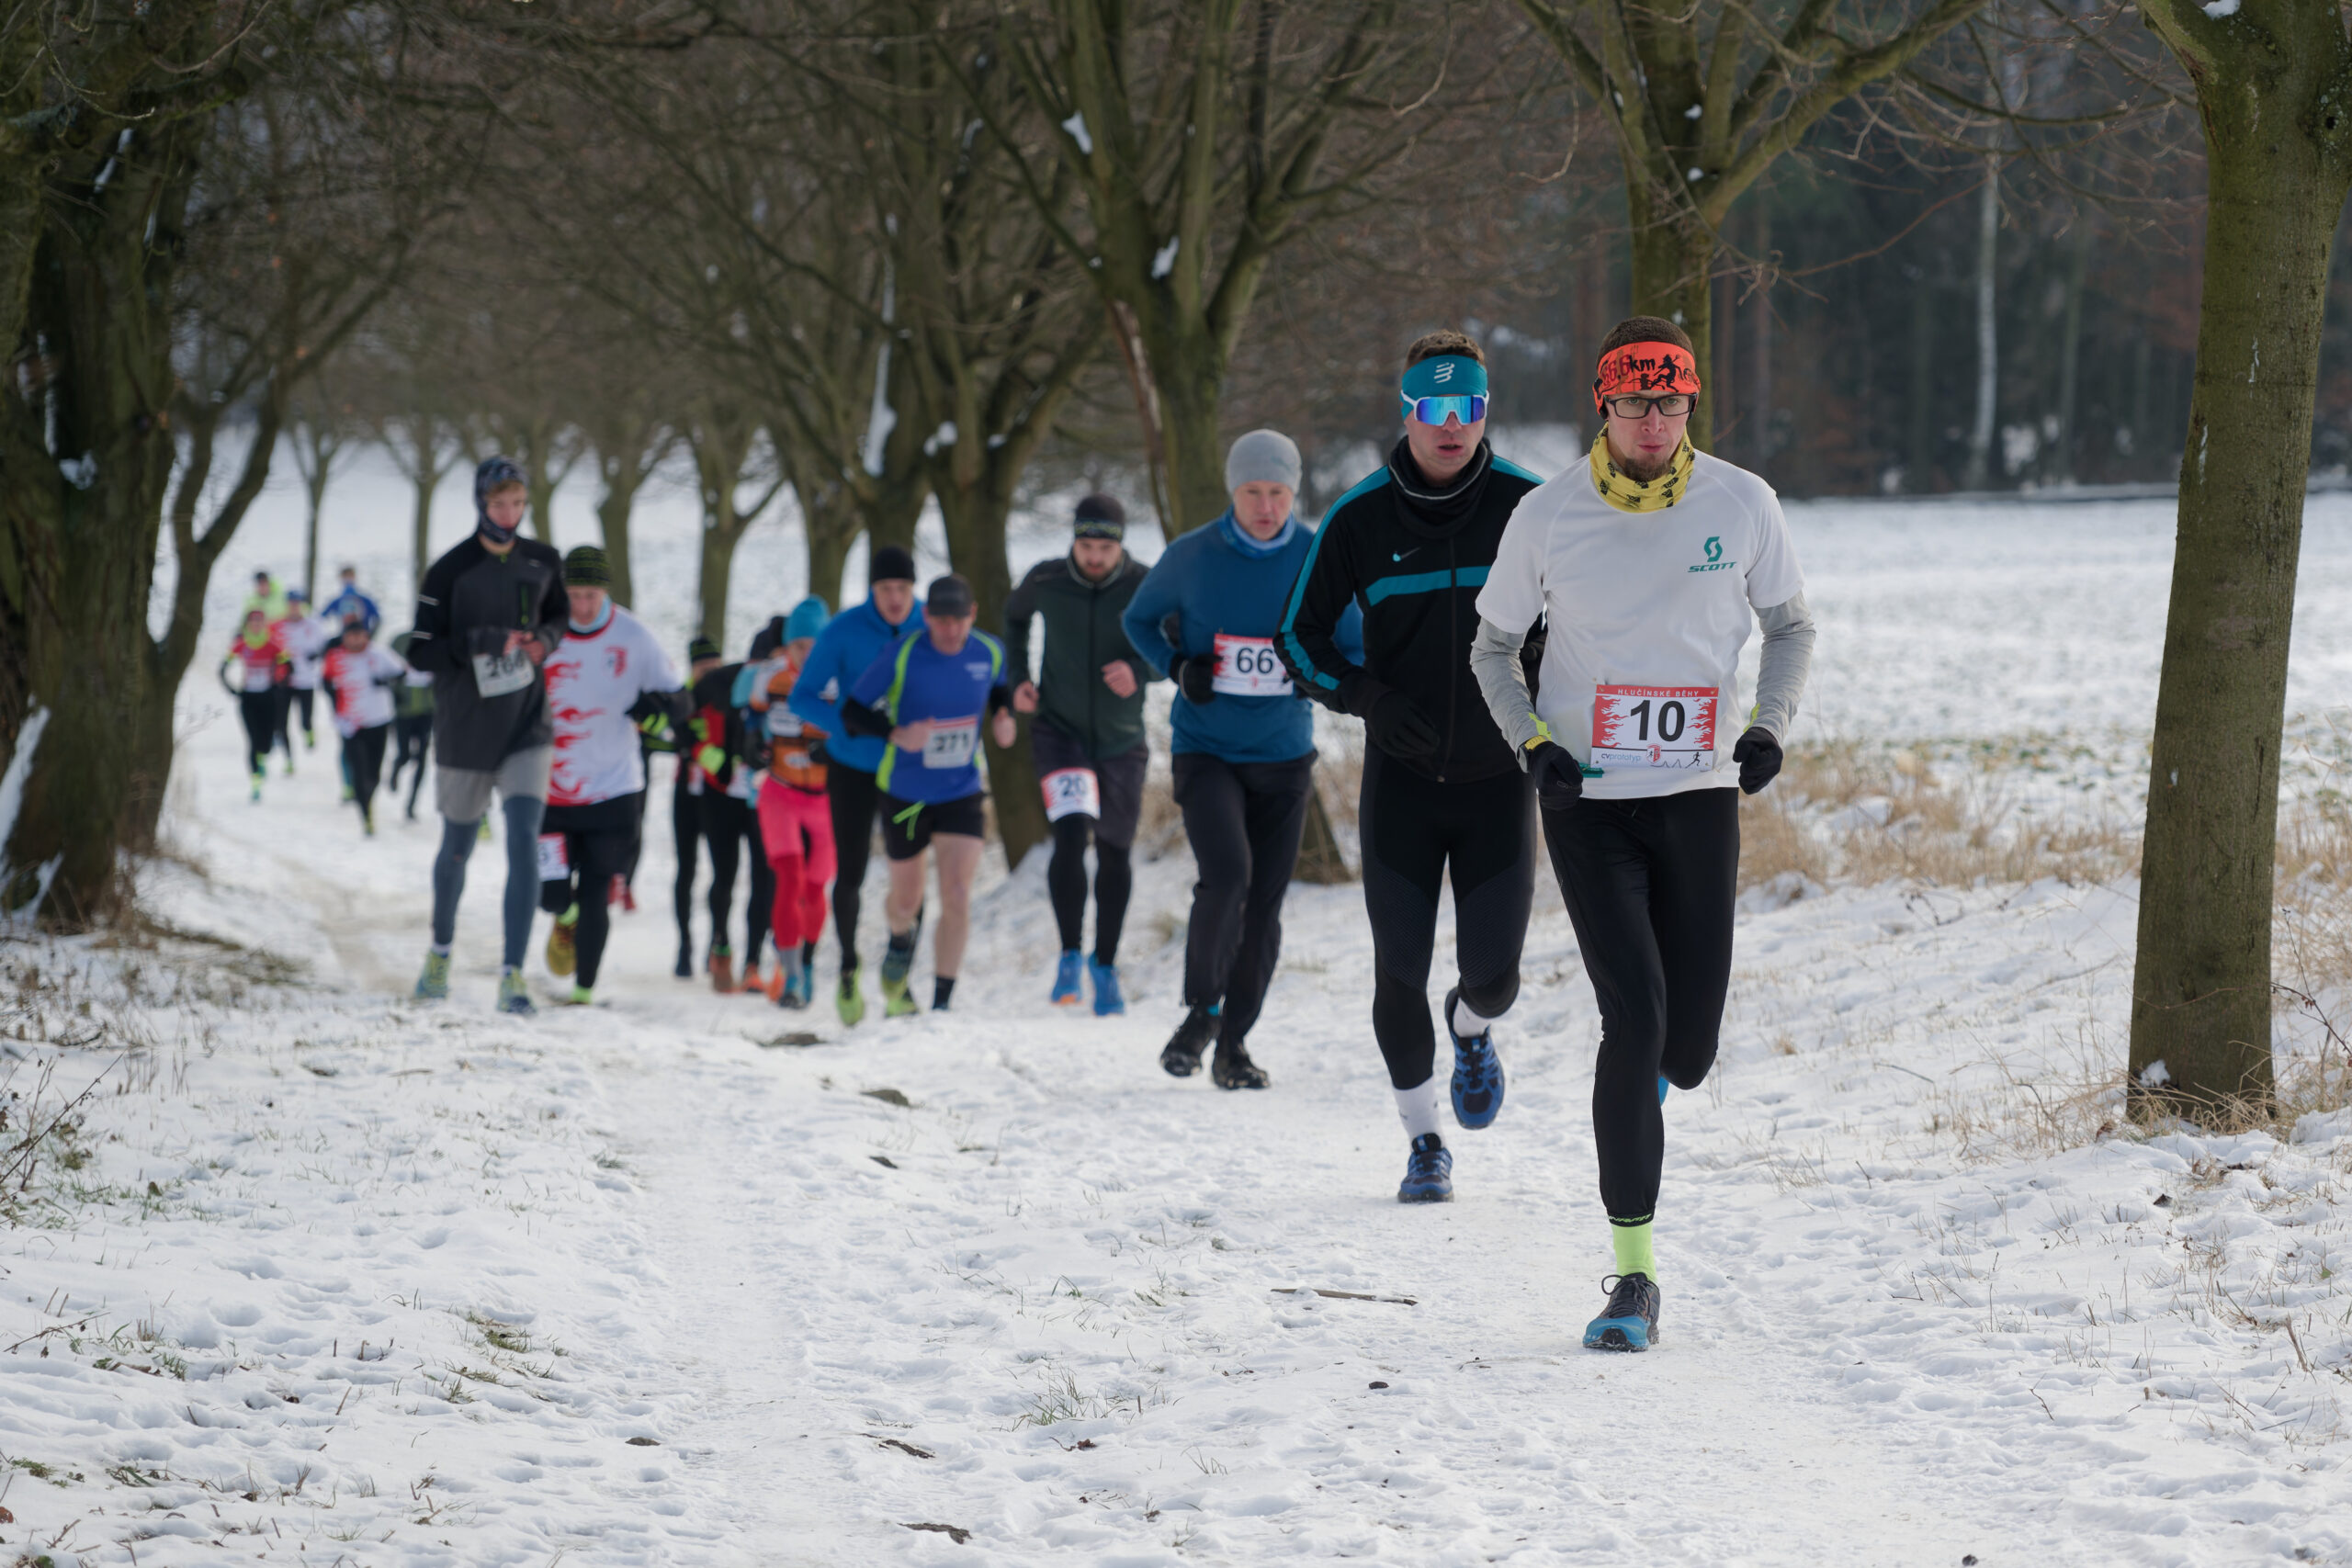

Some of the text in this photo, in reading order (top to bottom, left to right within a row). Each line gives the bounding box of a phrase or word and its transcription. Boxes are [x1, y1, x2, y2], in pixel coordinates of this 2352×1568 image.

[1688, 561, 1736, 572] SCOTT
[1237, 647, 1275, 674] 66
[1618, 688, 1671, 697] HLUČÍNSKÉ
[1630, 699, 1685, 742] 10
[1600, 753, 1642, 762] cvprototyp
